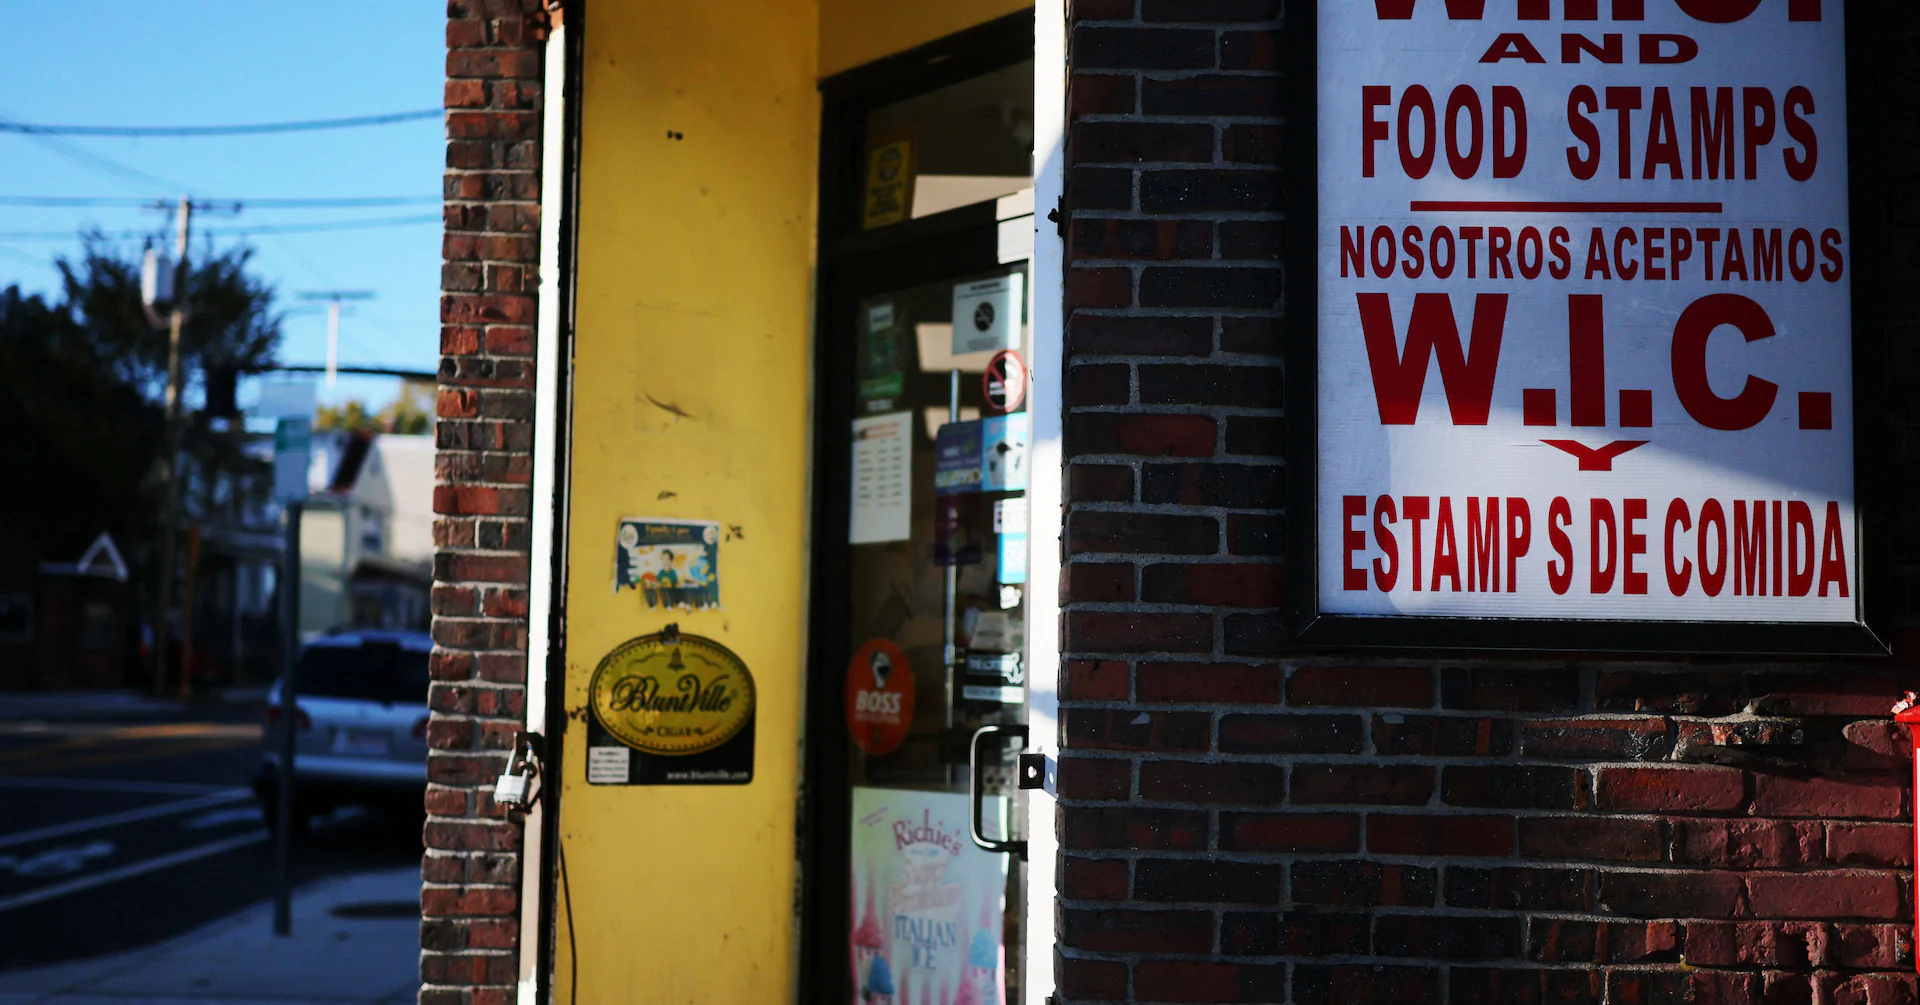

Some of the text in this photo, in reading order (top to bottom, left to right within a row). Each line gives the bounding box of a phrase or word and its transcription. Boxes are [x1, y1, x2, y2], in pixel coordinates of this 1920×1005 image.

[1479, 33, 1699, 64] AND
[1362, 84, 1818, 182] FOOD STAMPS
[1340, 225, 1844, 283] NOSOTROS ACEPTAMOS
[1356, 293, 1832, 431] W.I.C.
[1540, 439, 1650, 472] Y
[1589, 497, 1649, 595] DE
[1663, 498, 1850, 598] COMIDA
[856, 690, 902, 714] BOSS
[892, 808, 964, 856] Richie's
[895, 915, 957, 947] ITALIAN
